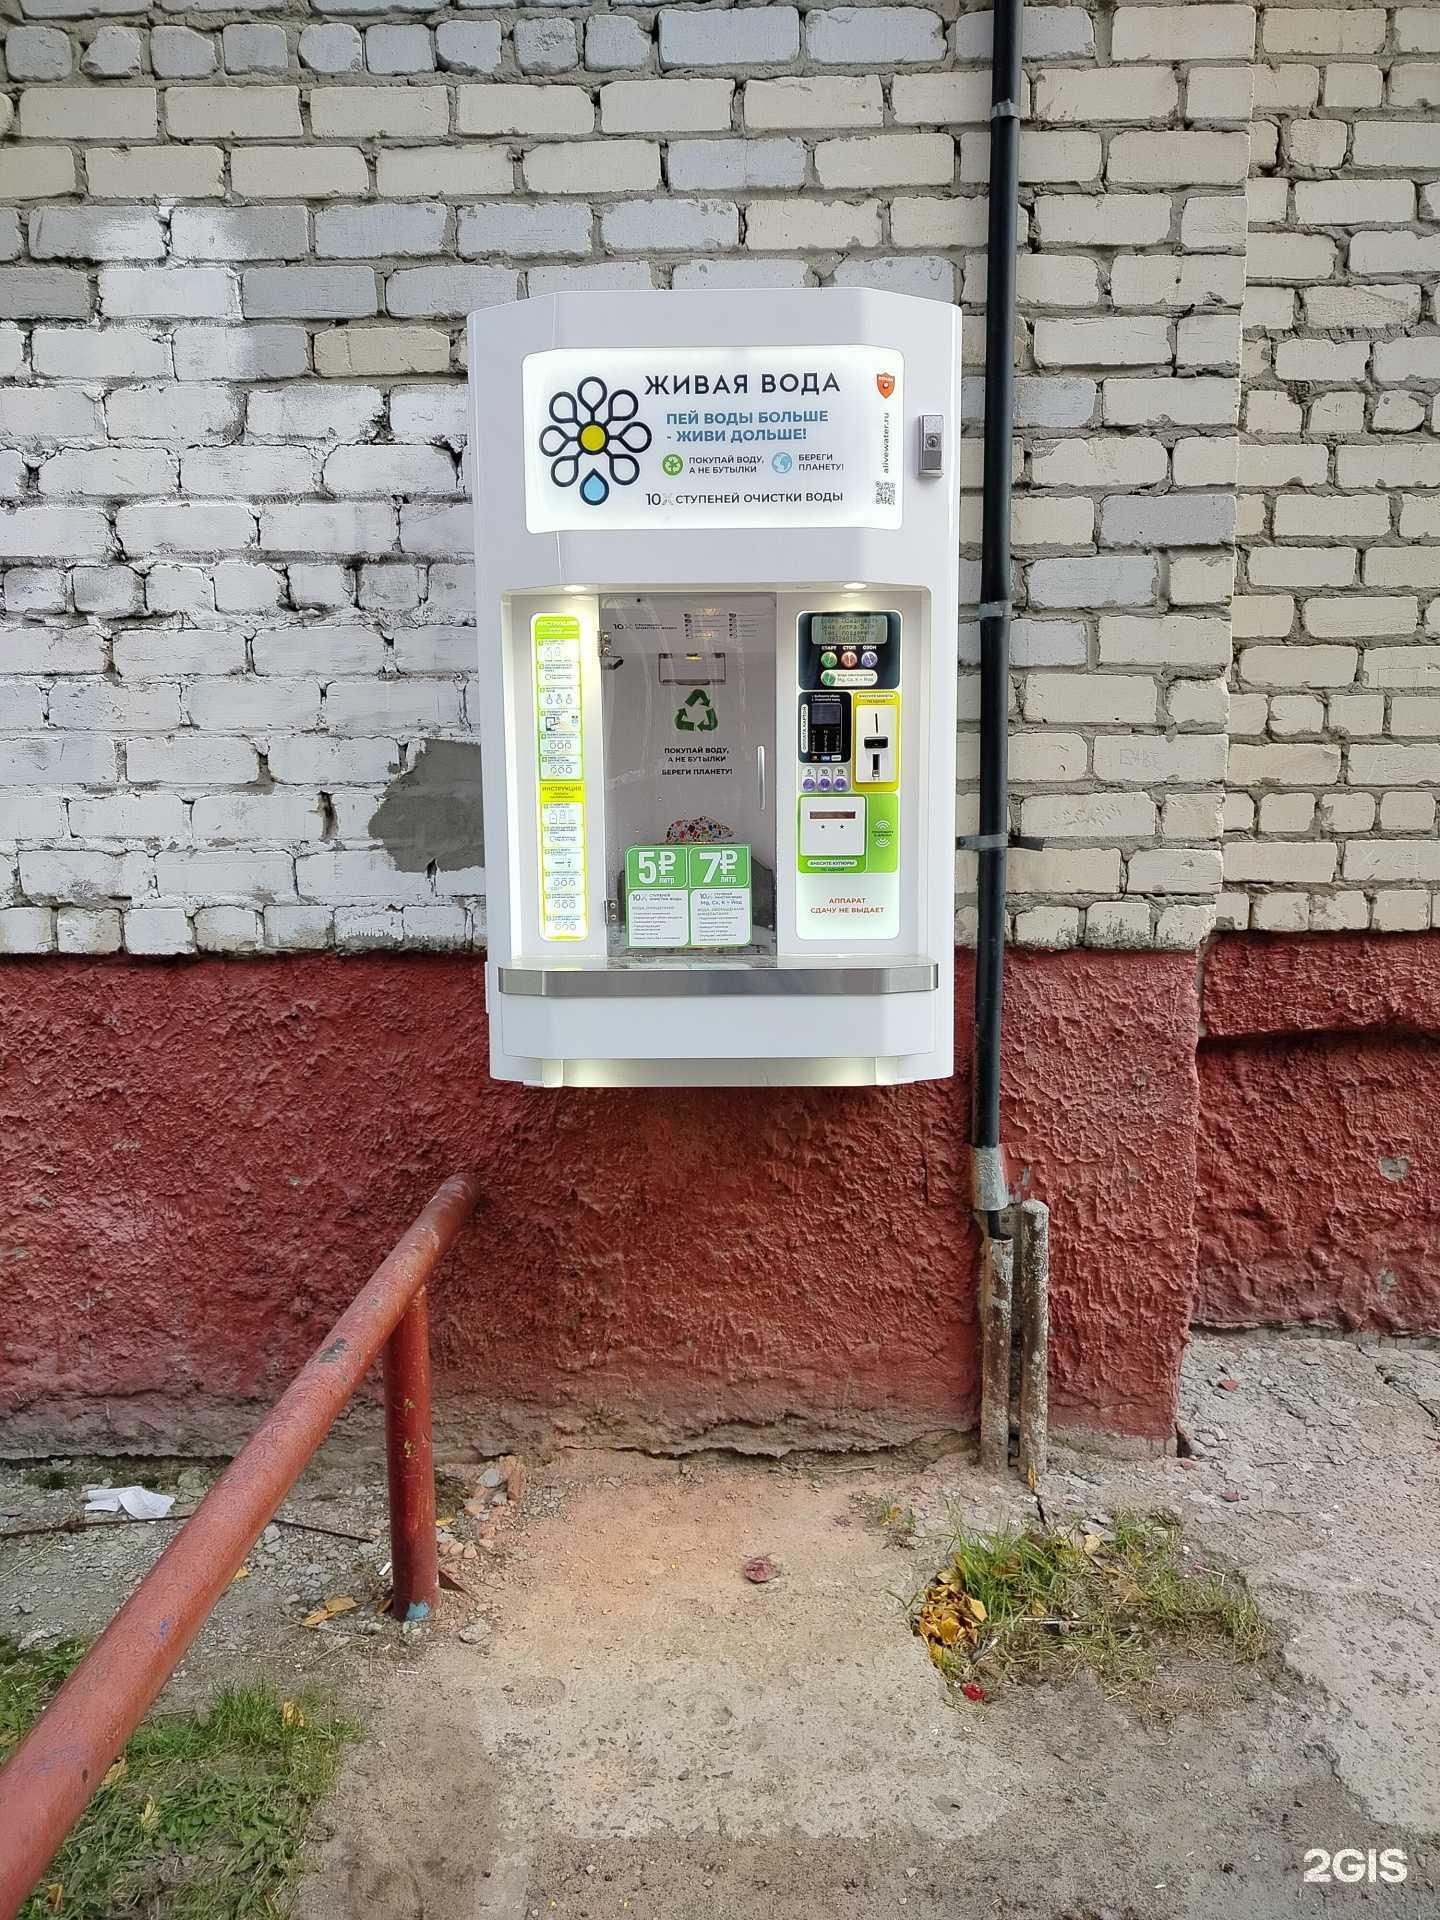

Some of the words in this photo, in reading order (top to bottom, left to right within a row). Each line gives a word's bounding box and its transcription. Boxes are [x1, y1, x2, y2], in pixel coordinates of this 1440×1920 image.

[644, 374, 748, 395] ЖИВАЯ
[761, 372, 841, 396] ВОДА
[666, 410, 699, 425] ПЕЙ
[704, 411, 753, 426] ВОДЫ
[758, 410, 829, 423] БОЛЬШЕ
[676, 430, 726, 443] ЖИВИ
[730, 428, 807, 443] ДОЛЬШЕ!
[882, 412, 890, 474] alivewater.ru
[689, 455, 734, 464] ПОКУПАЙ
[736, 455, 764, 465] ВОДУ,
[798, 453, 833, 462] БЕРЕГИ
[697, 466, 711, 474] НЕ
[712, 466, 757, 474] БУТЫЛКИ
[798, 463, 844, 471] ПЛАНЕТУ!
[675, 492, 740, 504] СТУПЕНЕЙ
[743, 493, 801, 503] ОЧИСТКИ
[805, 491, 843, 503] ВОДЫ
[664, 745, 703, 754] ПОКУПАЙ
